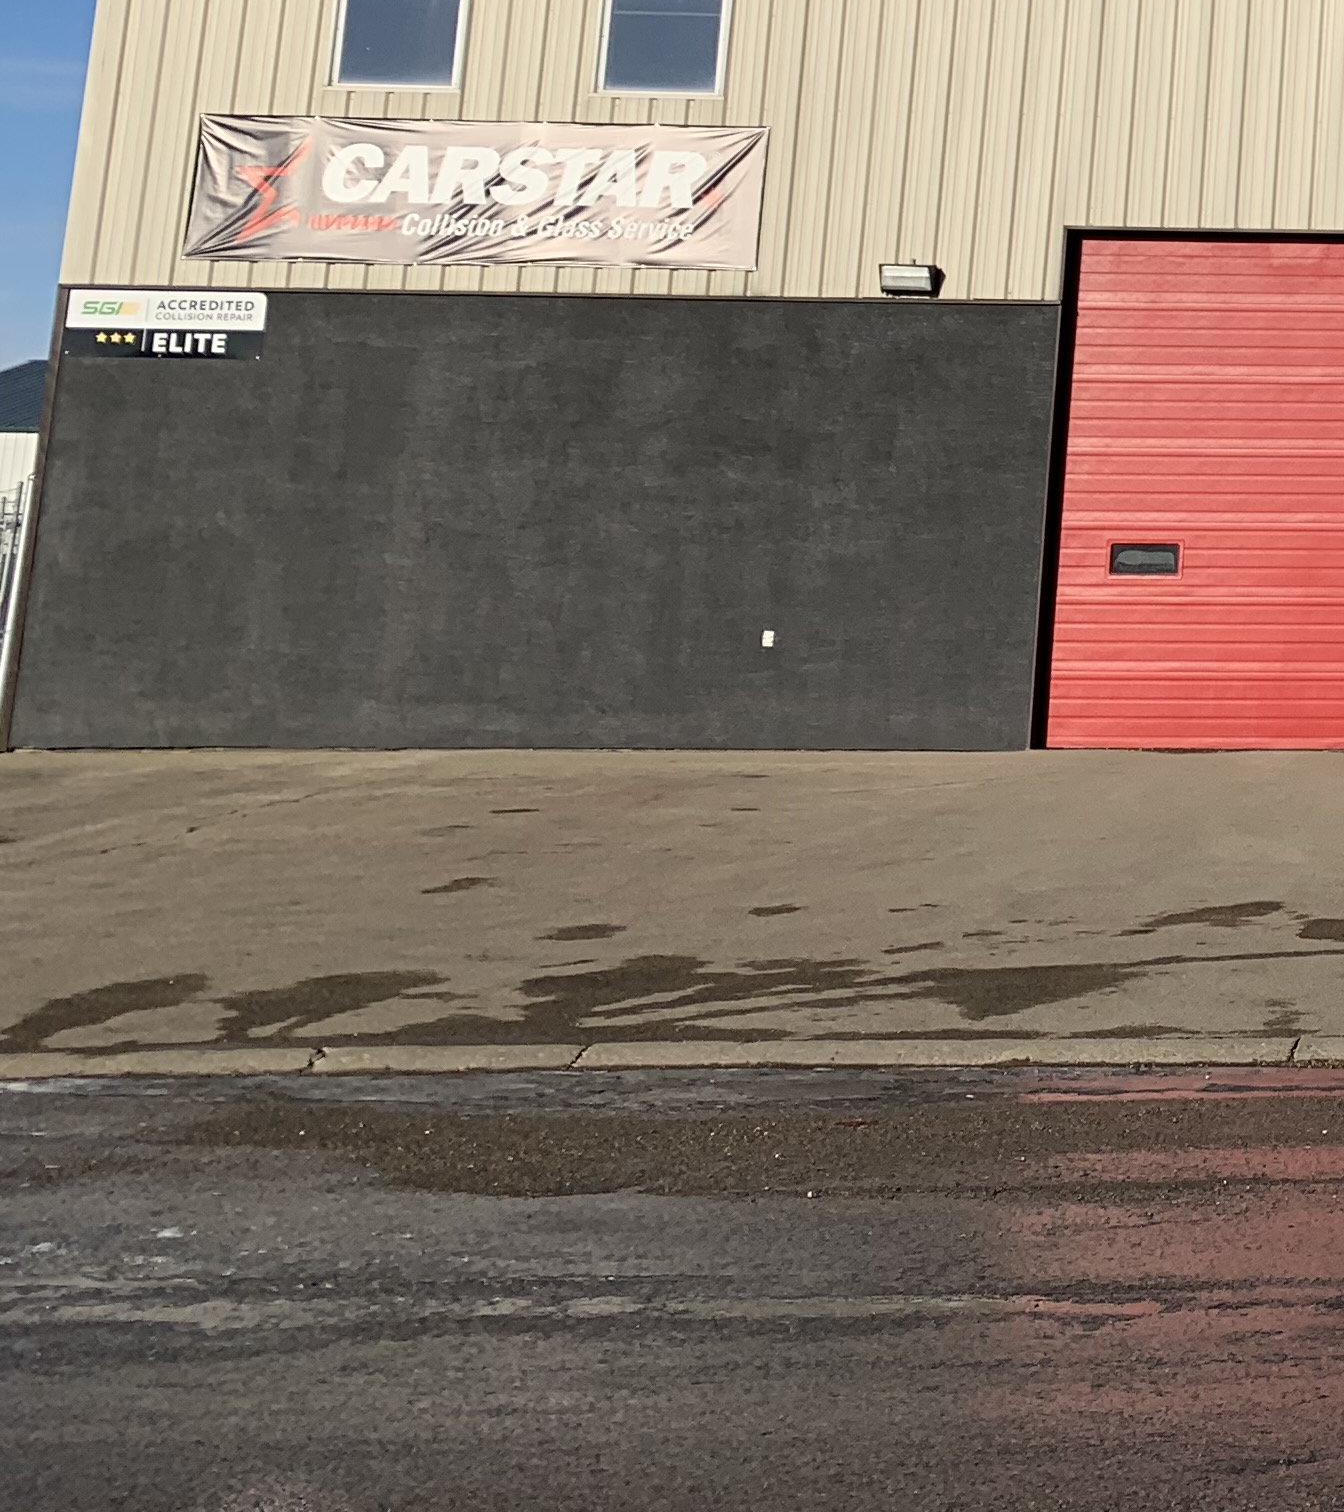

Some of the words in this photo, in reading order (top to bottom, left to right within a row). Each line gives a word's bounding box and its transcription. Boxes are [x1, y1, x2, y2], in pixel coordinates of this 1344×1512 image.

[322, 143, 708, 209] CARSTAR
[401, 212, 504, 237] Collision
[511, 214, 534, 237] &
[537, 216, 603, 238] Glass
[608, 217, 695, 240] Service
[81, 300, 124, 316] SGI
[156, 299, 255, 312] ACCREDITED
[155, 312, 214, 321] COLLISION
[216, 312, 253, 322] REPAIR
[151, 332, 228, 354] ELITE
